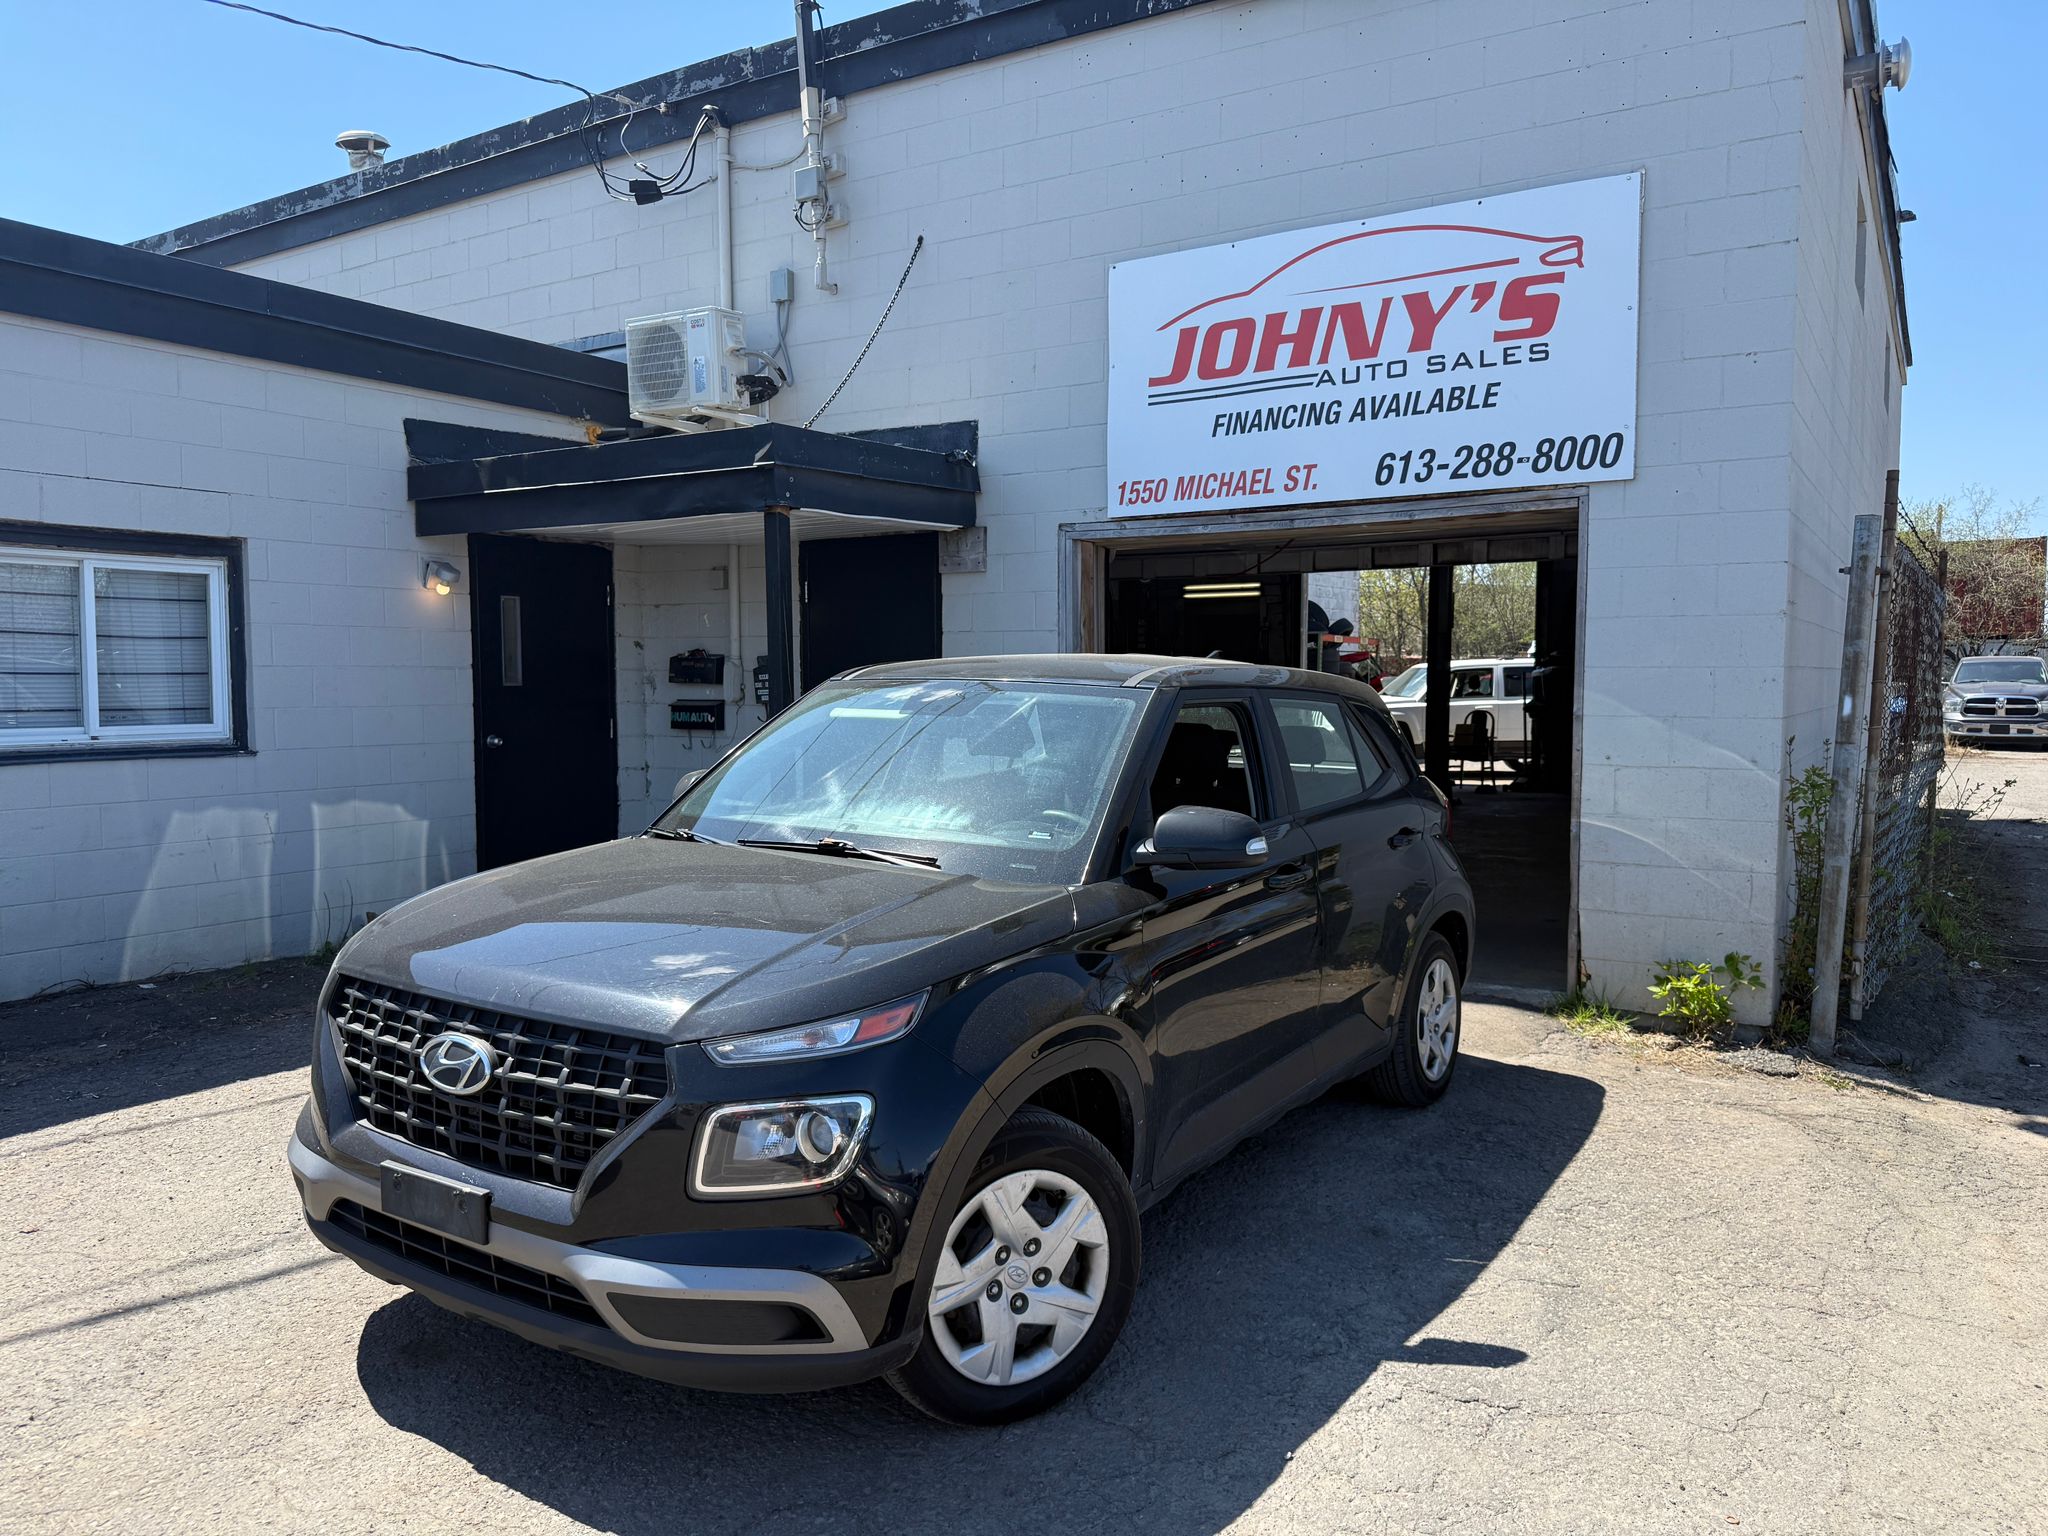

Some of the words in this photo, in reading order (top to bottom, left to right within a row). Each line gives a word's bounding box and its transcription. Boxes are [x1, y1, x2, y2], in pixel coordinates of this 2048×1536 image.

[1148, 271, 1566, 388] JOHNY'S
[1315, 359, 1408, 389] AUTO
[1426, 342, 1550, 374] SALES
[1212, 400, 1342, 437] FINANCING
[1349, 381, 1501, 423] AVAILABLE
[1117, 477, 1168, 507] 1550
[1173, 467, 1276, 502] MICHAEL
[1283, 463, 1319, 492] ST.
[1374, 432, 1623, 486] 613-288-8000
